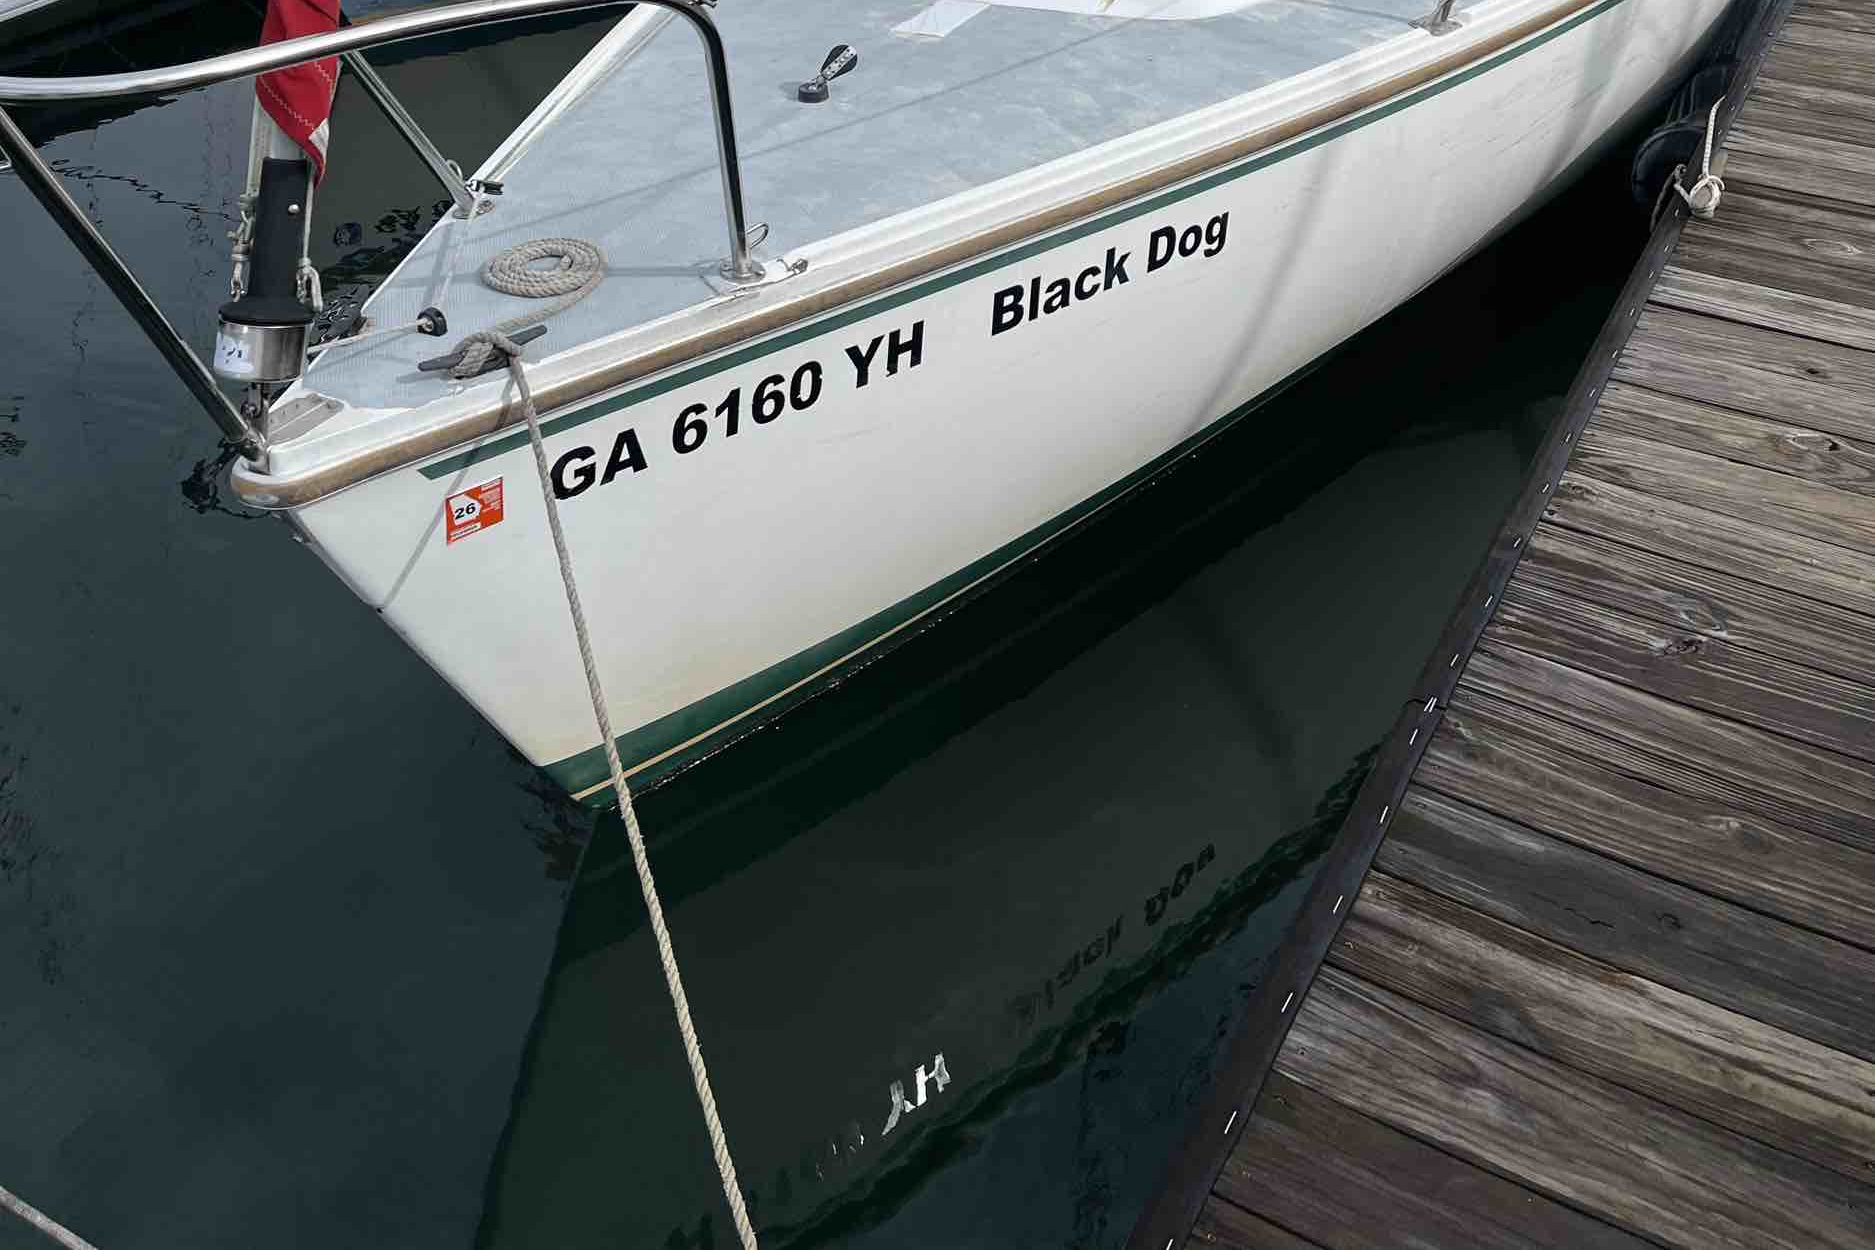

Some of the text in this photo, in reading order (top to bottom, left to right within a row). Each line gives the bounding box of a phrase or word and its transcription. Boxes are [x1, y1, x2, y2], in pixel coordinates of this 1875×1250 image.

[550, 428, 648, 500] GA
[672, 360, 823, 454] 6160
[845, 320, 924, 389] YH
[991, 247, 1131, 336] Black
[1147, 211, 1229, 273] Dog
[454, 502, 476, 520] 26
